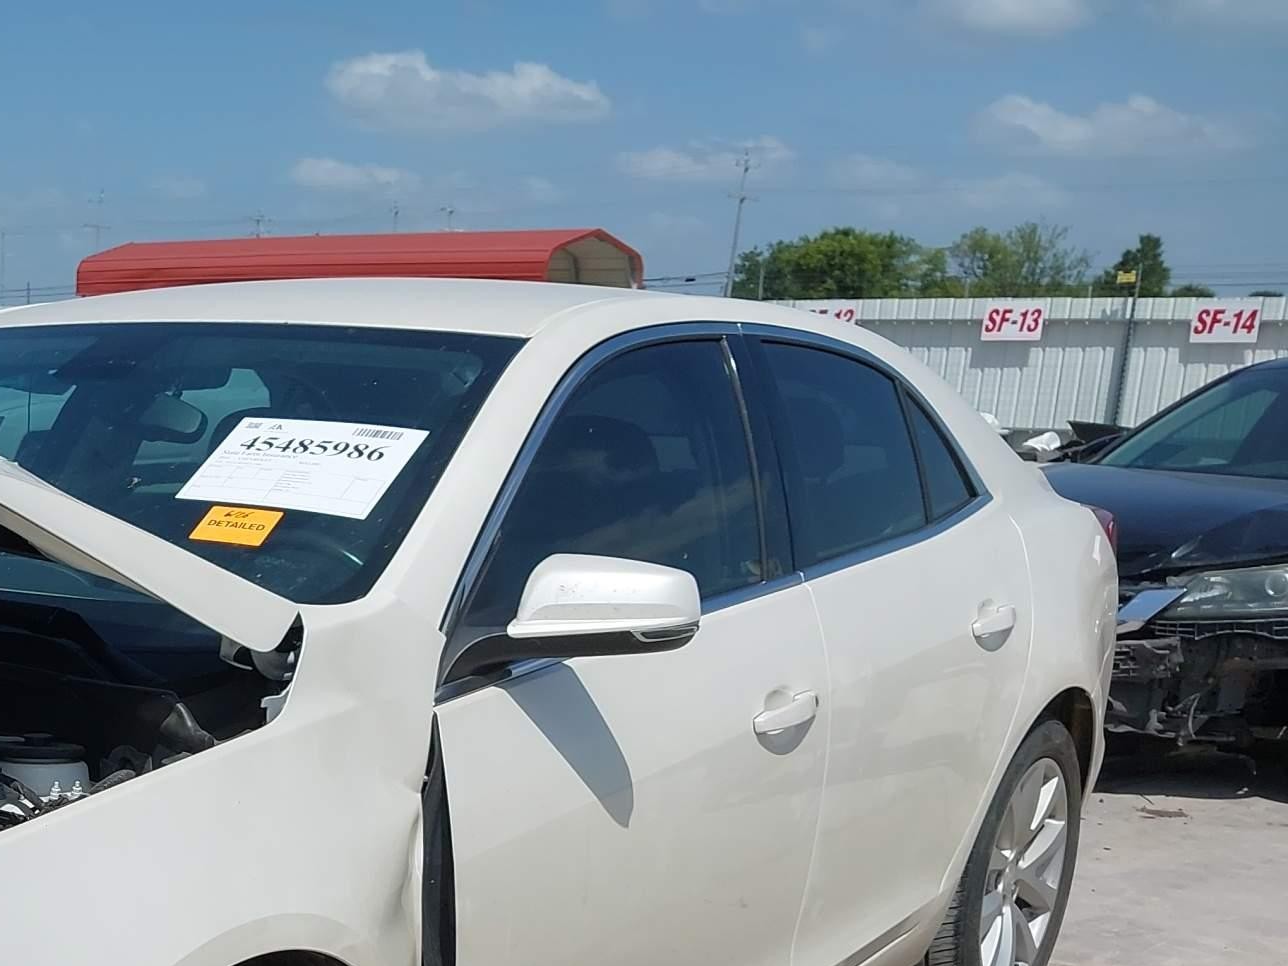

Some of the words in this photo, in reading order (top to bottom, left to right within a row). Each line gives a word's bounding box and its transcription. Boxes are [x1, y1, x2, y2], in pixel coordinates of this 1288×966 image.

[984, 308, 1042, 333] SF-13
[1193, 309, 1259, 334] SF-14
[240, 435, 392, 461] 45485986
[207, 519, 265, 531] DETAILED
